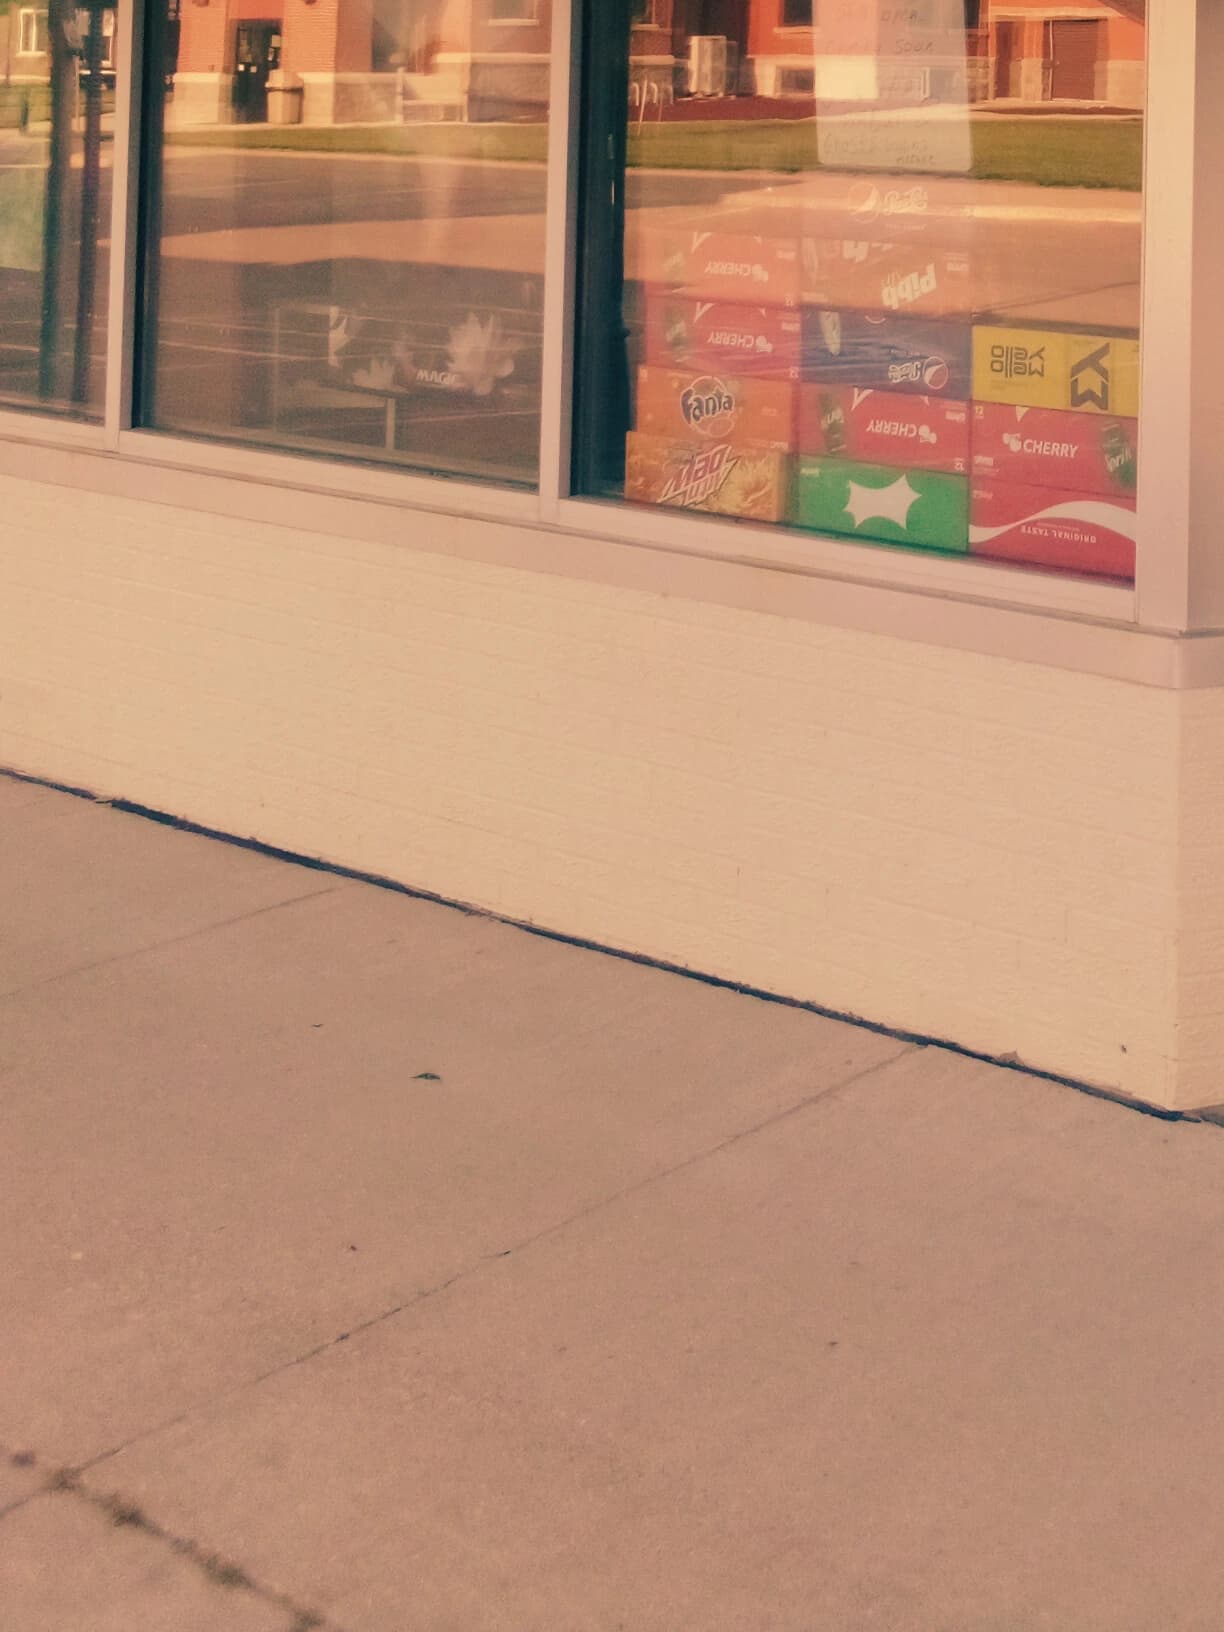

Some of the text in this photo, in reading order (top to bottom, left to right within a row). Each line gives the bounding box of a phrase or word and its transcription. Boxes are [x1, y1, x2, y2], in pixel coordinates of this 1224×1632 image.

[704, 261, 751, 276] CHERRY
[708, 331, 755, 349] CHERRY
[866, 420, 917, 438] CHERRY
[1023, 439, 1079, 459] CHERRY
[1021, 525, 1097, 544] ORIGINAL TASTE
